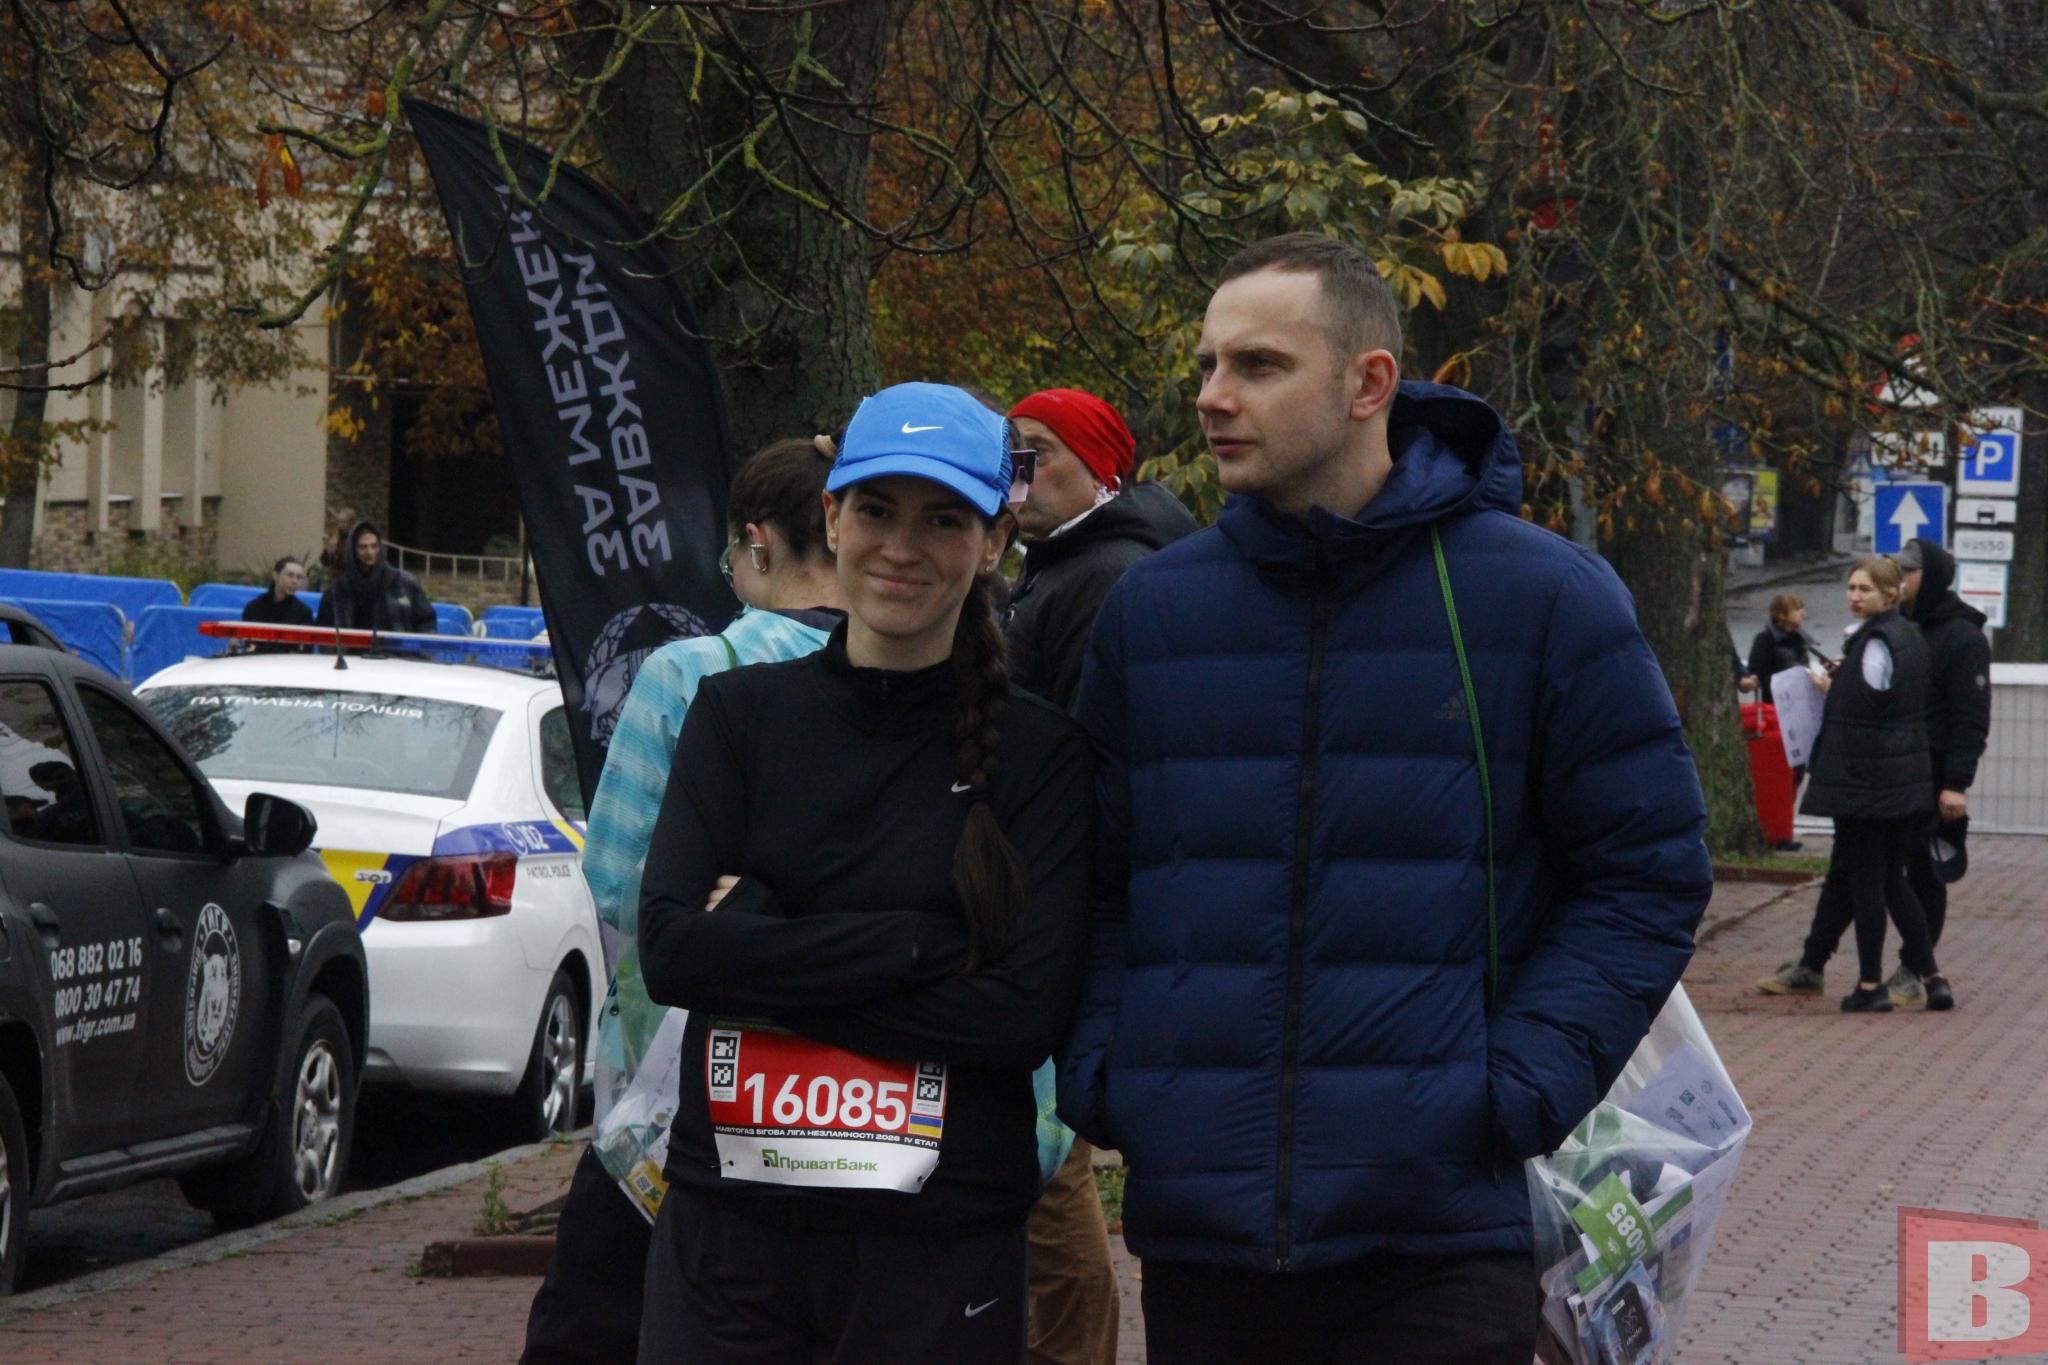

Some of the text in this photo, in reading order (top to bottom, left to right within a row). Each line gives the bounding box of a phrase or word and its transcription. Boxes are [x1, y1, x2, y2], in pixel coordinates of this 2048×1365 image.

[1975, 440, 2004, 477] P
[190, 695, 424, 719] ПАТРУЛЬНА ПОЛІЦІЯ
[517, 825, 550, 850] 102
[526, 864, 572, 879] PATROL POLICE
[200, 905, 230, 937] ТИГР
[51, 937, 142, 981] 068 882 02 16
[55, 976, 141, 1019] 0800 30 47 74
[56, 1013, 137, 1047] www.tigr.com.ua
[744, 1072, 908, 1130] 16085
[715, 1125, 755, 1135] НАФТОГАЗ
[756, 1128, 785, 1136] БІГОВА
[786, 1129, 806, 1137] ЛІГА
[807, 1130, 874, 1140] НЕЗЛАМНОСТІ
[914, 1138, 938, 1148] ЕТАП
[779, 1156, 878, 1173] ПриватБанк
